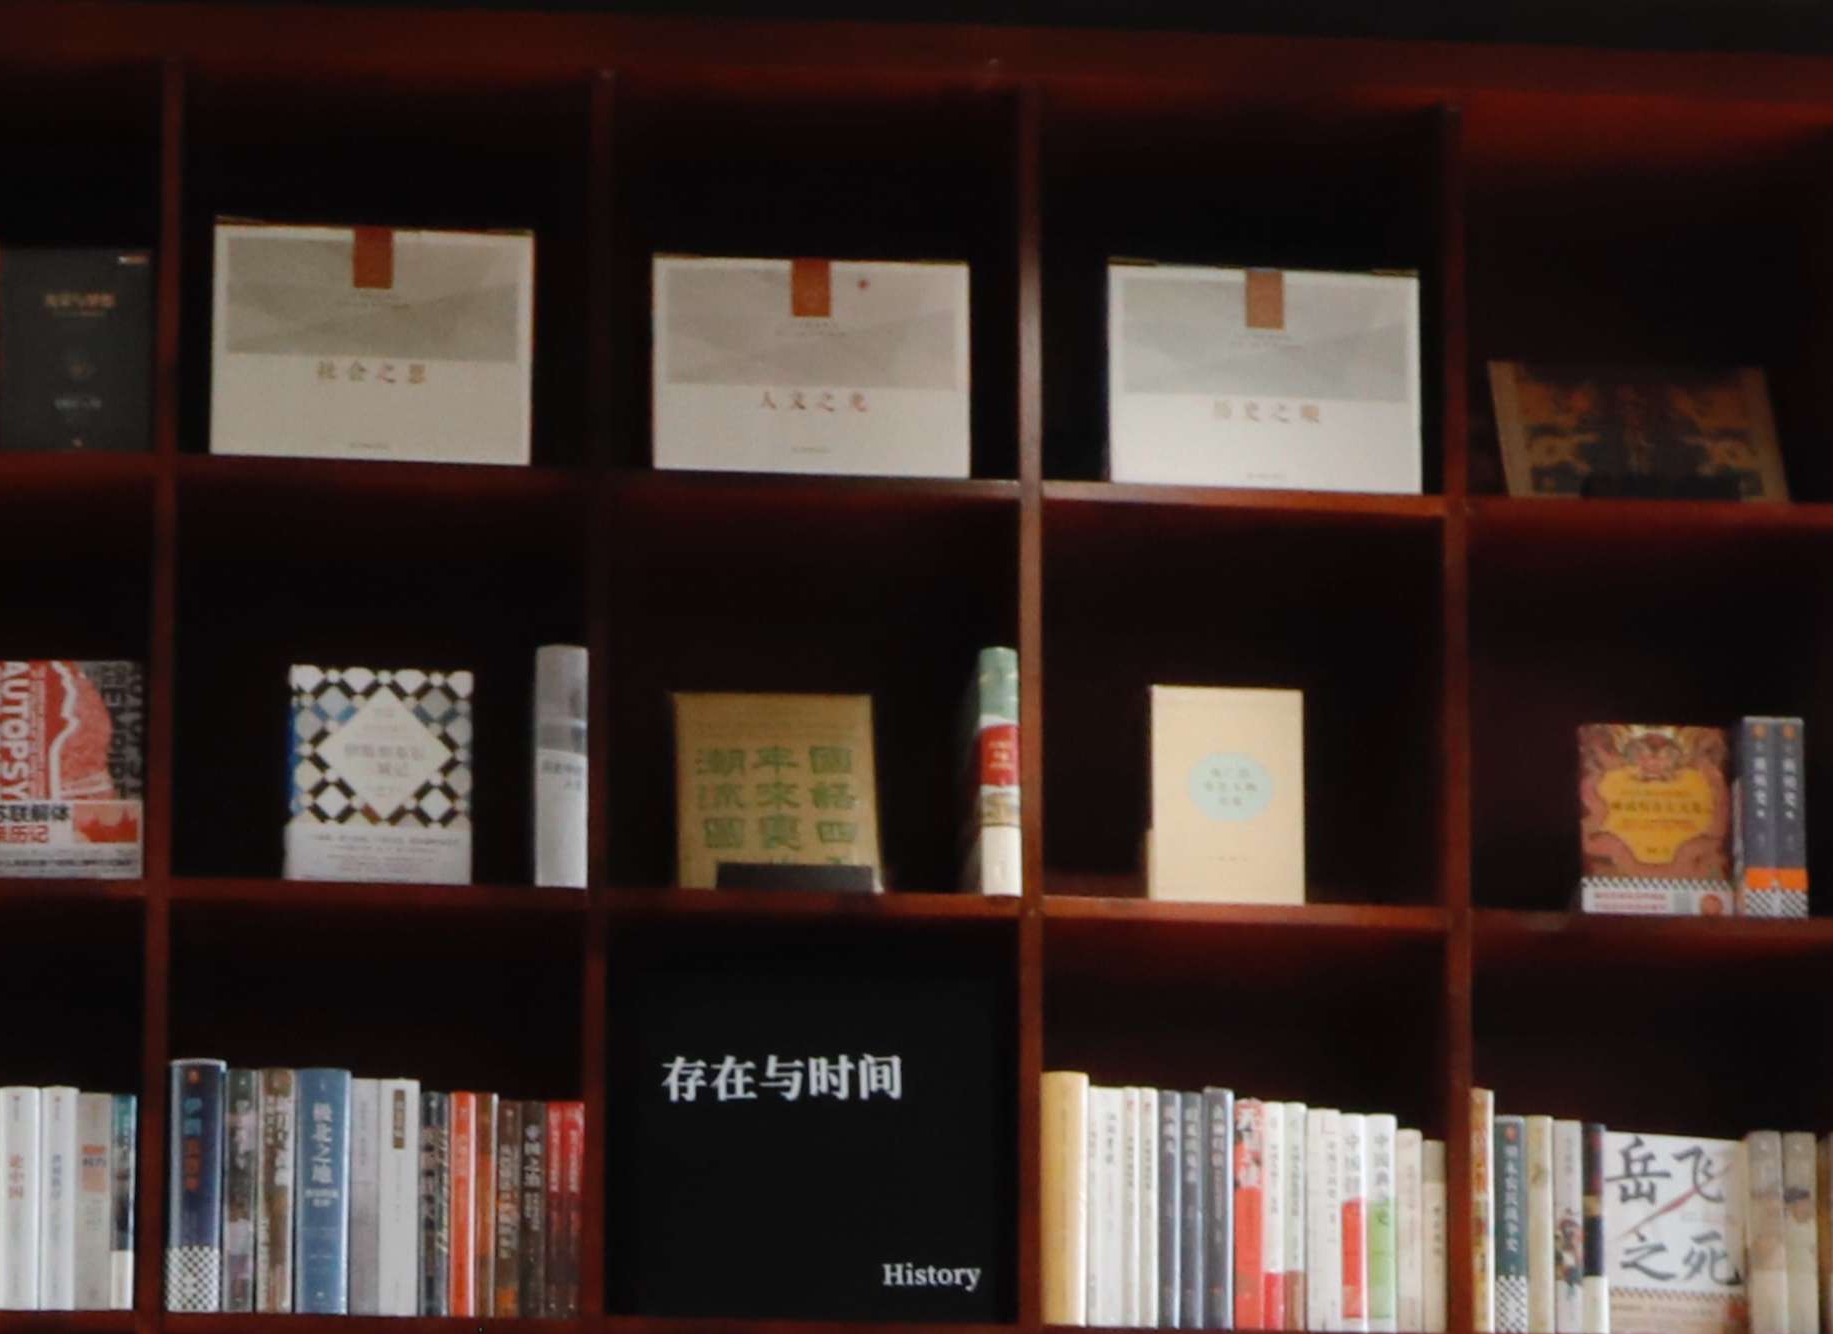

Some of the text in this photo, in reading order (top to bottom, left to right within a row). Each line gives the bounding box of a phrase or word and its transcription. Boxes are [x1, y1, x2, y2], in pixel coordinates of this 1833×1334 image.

[758, 392, 869, 414] 人文之光
[662, 1054, 904, 1102] 存在与时间
[1605, 1135, 1727, 1208] 岳飞
[883, 1263, 981, 1293] History
[1619, 1230, 1743, 1288] 之死
